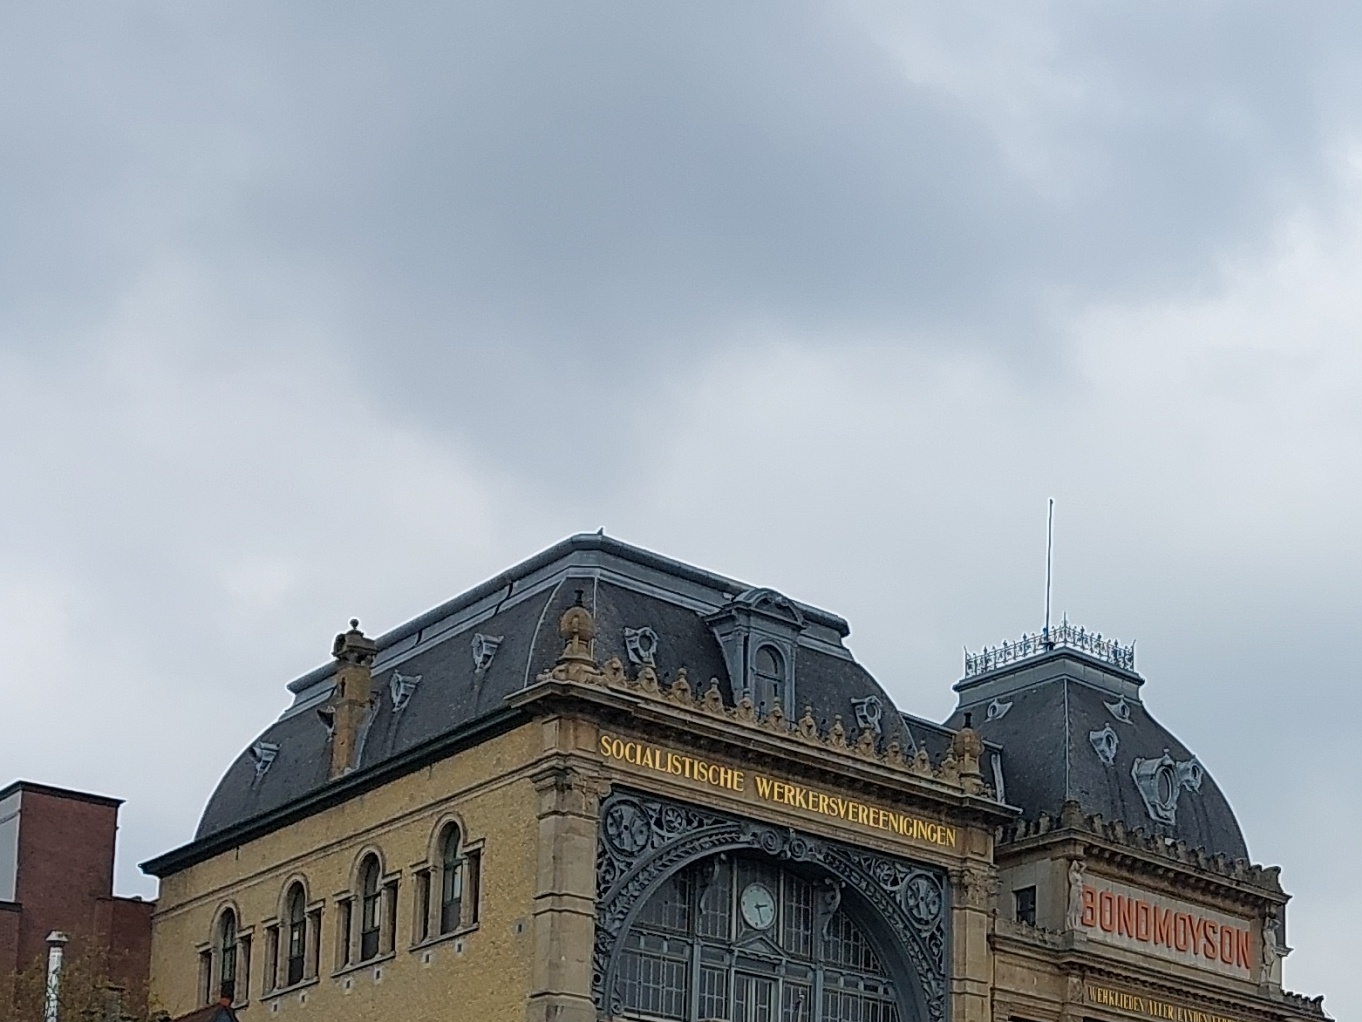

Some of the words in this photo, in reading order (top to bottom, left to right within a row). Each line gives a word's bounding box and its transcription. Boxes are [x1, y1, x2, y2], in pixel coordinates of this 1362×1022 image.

[600, 735, 744, 792] SOCIALISTISCHE
[755, 776, 957, 848] WERKERSVEREENIGINGEN
[1147, 1000, 1174, 1021] ALLER
